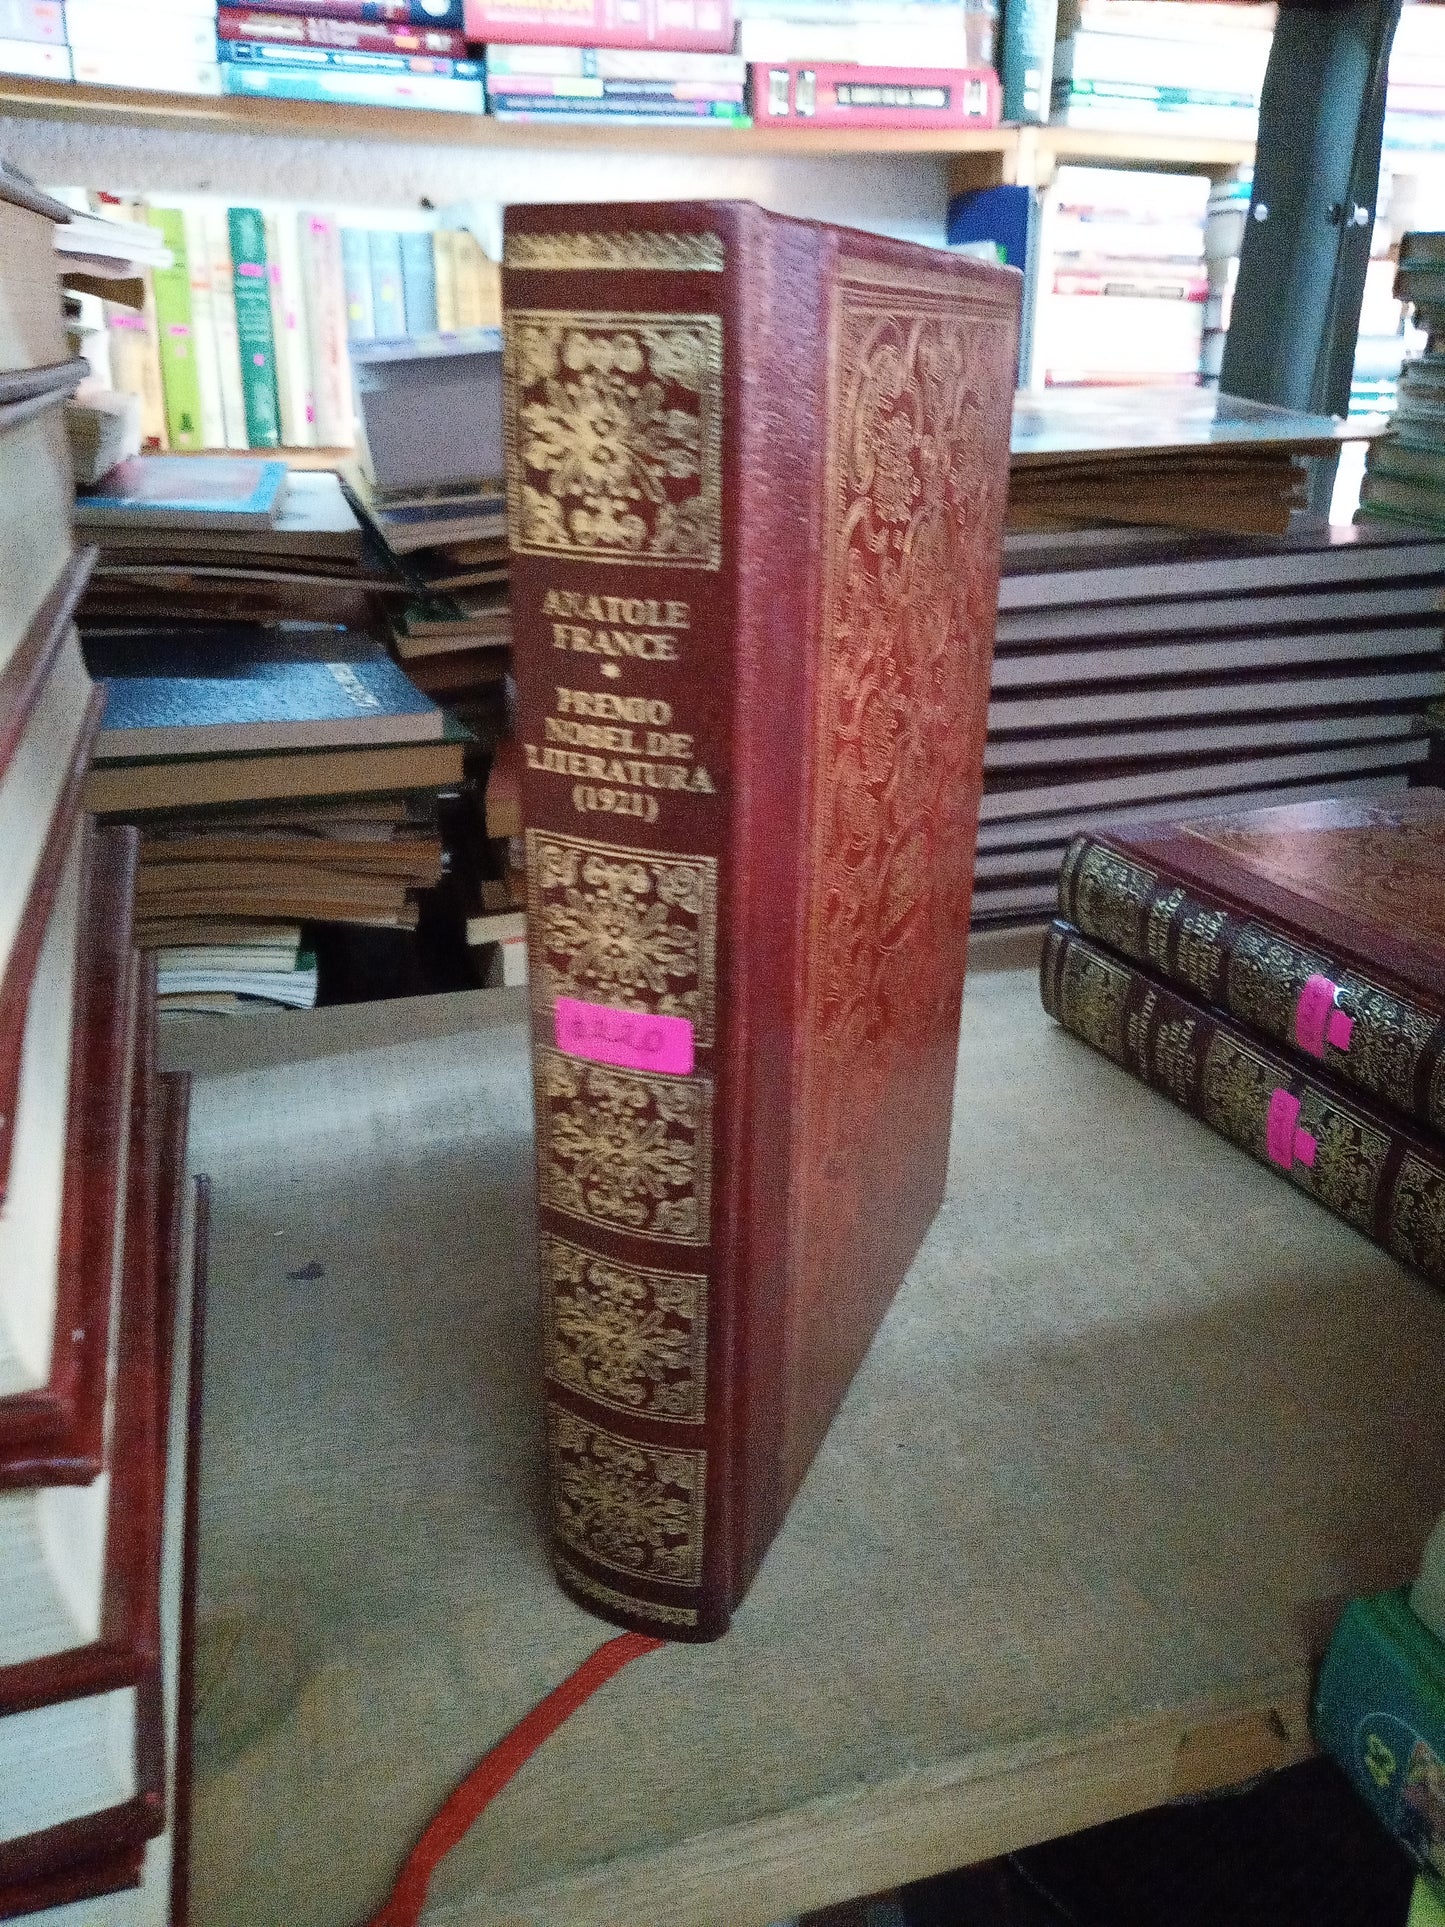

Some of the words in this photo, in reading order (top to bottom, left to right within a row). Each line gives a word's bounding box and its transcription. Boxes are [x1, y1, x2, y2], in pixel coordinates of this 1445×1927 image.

[543, 587, 690, 629] ANATOLE
[553, 623, 680, 661] FRANCE
[556, 687, 673, 726] PREMIO
[545, 718, 643, 755] NOBEL
[646, 732, 695, 760] DE
[524, 744, 717, 795] LITERATURA
